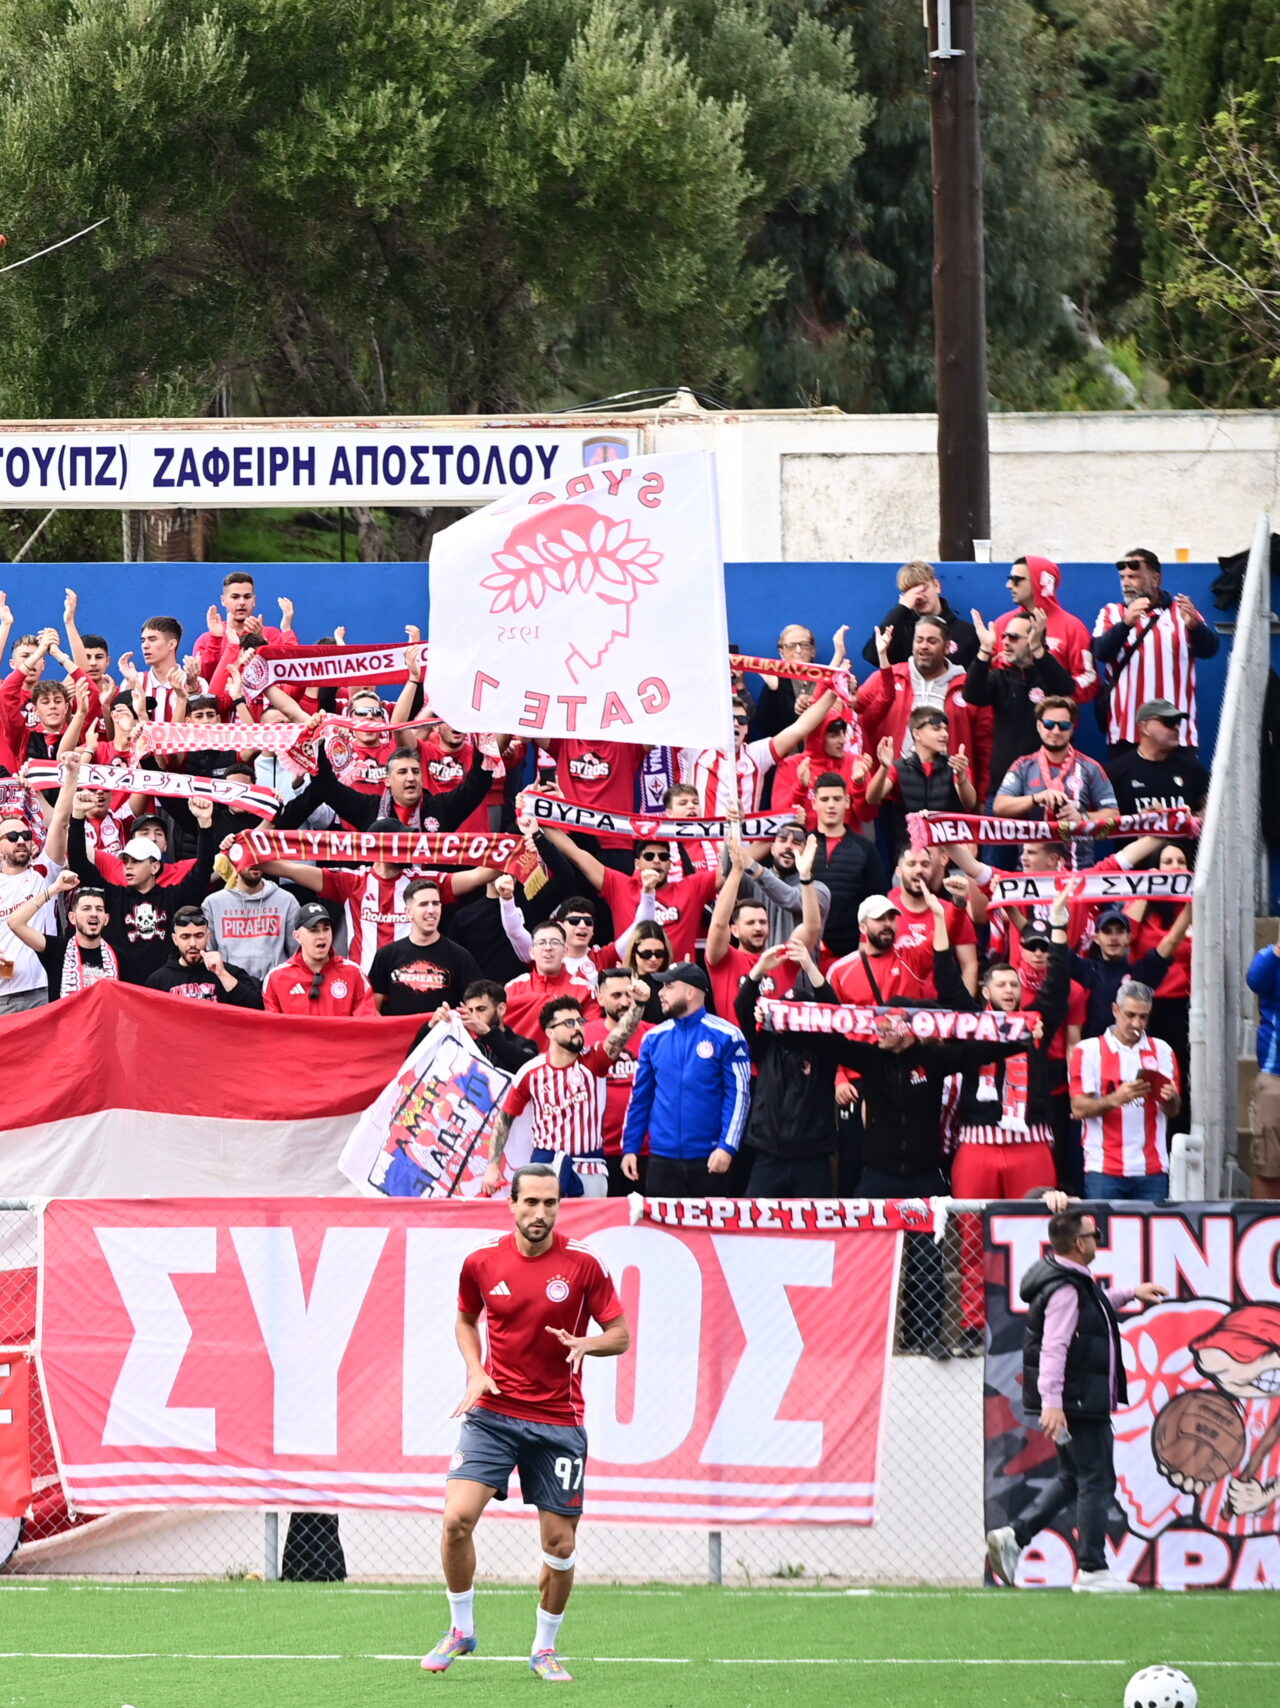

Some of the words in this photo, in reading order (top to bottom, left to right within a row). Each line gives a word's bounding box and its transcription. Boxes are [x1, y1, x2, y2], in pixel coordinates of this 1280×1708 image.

[153, 446, 316, 487] ΖΑΦΕΙΡΗ
[329, 444, 559, 486] ΑΠΟΣΤΟΛΟΥ
[273, 654, 395, 678] ΟΛΥΜΠΙΑΚΟΣ
[569, 759, 609, 777] SYROS
[534, 798, 616, 831] ΘΥΡΑ
[251, 830, 516, 863] OLYMPIACOS
[929, 823, 974, 844] ΝΕΑ
[978, 820, 1053, 842] ΛΙΟΣΙΑ
[999, 878, 1040, 899] ΡΑ
[1101, 873, 1193, 896] ΣΥΡΟ
[222, 919, 277, 936] PIRAEUS
[362, 908, 411, 924] Stoixima
[770, 1002, 875, 1034] ΤΗΝΟΣ
[911, 1011, 1002, 1042] ΘΥΡΑ
[647, 1197, 888, 1230] ΠΕΡΙΣΤΕΡΙ
[554, 1457, 584, 1491] 97
